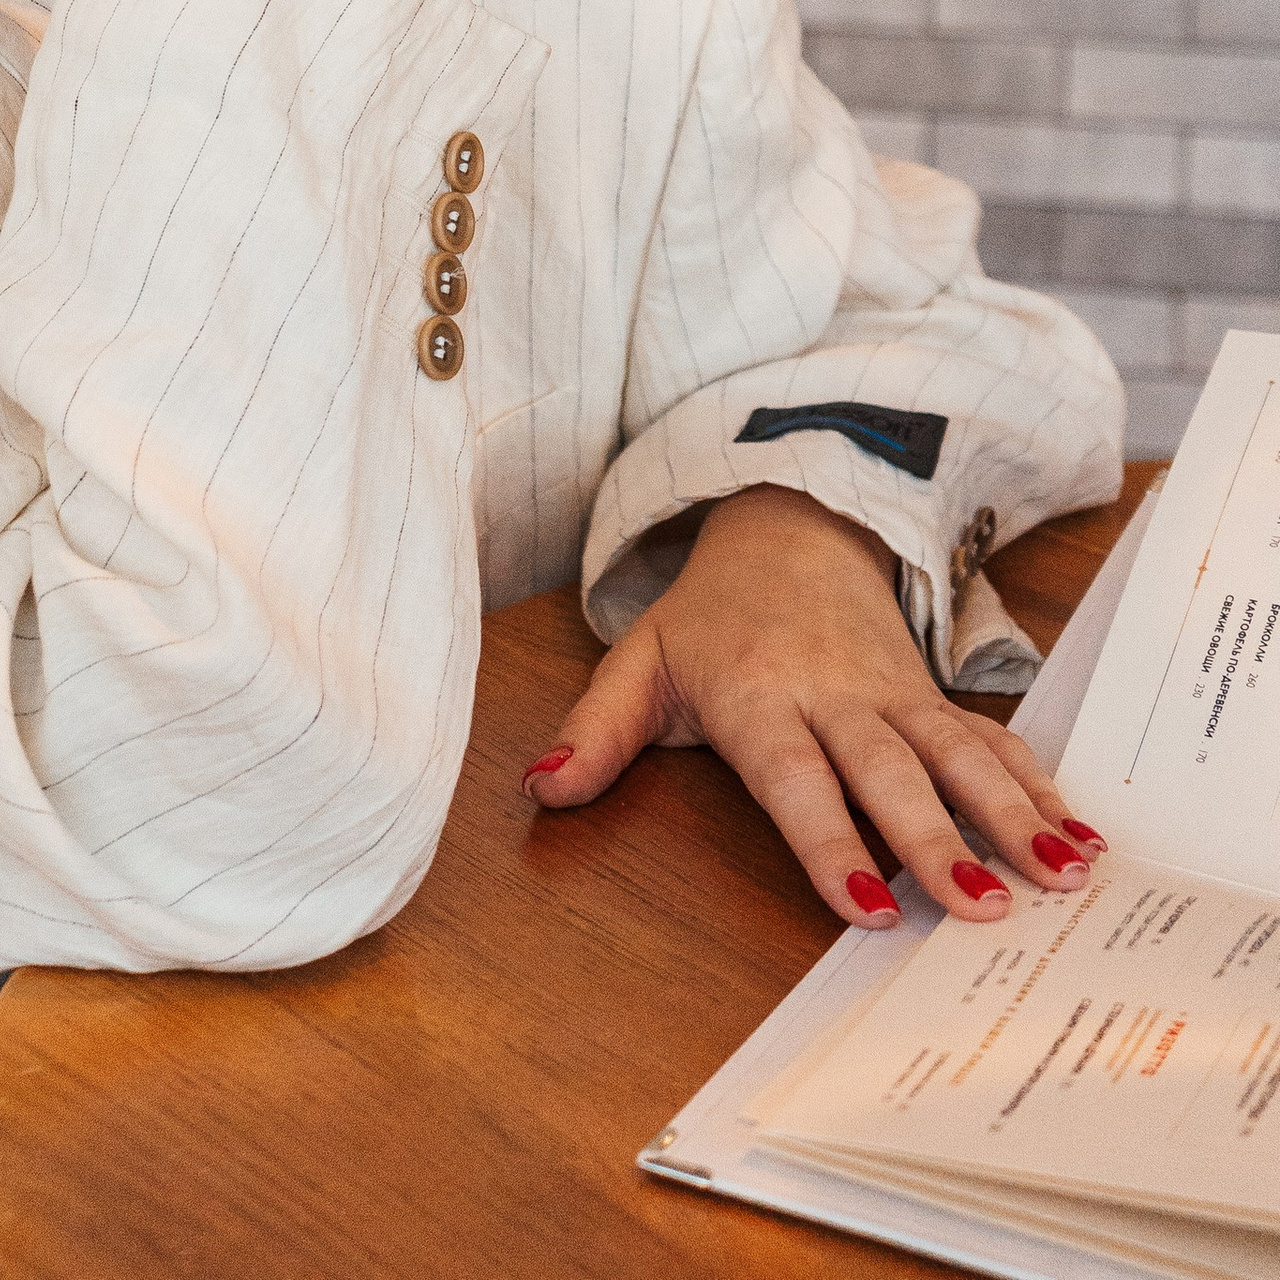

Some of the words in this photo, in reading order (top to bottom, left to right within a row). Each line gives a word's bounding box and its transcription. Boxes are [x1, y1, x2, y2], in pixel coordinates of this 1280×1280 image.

[1215, 594, 1235, 634] СВЕЖИЕ
[1231, 598, 1258, 657] КАРТОФЕЛЬ
[1254, 603, 1280, 663] БРОККОЛЛИ
[1201, 633, 1222, 674] ОВОЩИ
[1192, 683, 1205, 699] 230
[1204, 657, 1239, 739] ПО-ДЕРЕВЕНСКИ
[1246, 672, 1259, 689] 260
[1195, 748, 1208, 764] 170
